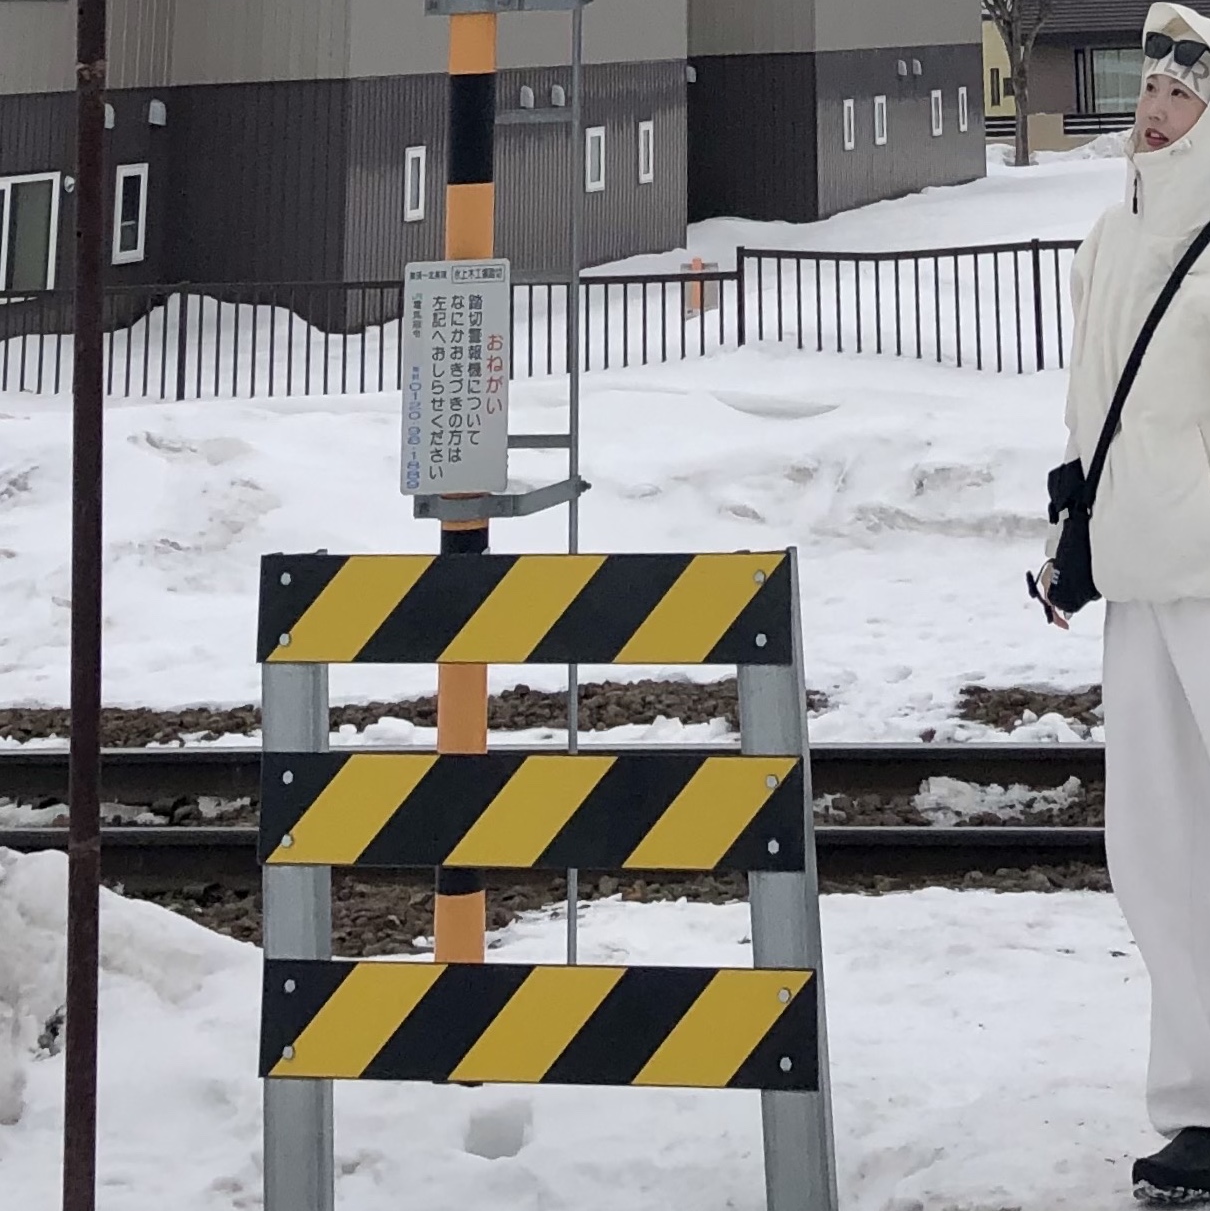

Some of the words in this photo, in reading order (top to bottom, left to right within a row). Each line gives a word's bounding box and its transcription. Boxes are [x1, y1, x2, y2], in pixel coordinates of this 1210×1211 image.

[429, 296, 447, 479] 左記へおしらせください
[448, 295, 464, 463] なにかおきづきの方は
[467, 294, 483, 445] 踏切警報機について
[486, 334, 504, 415] おねがい
